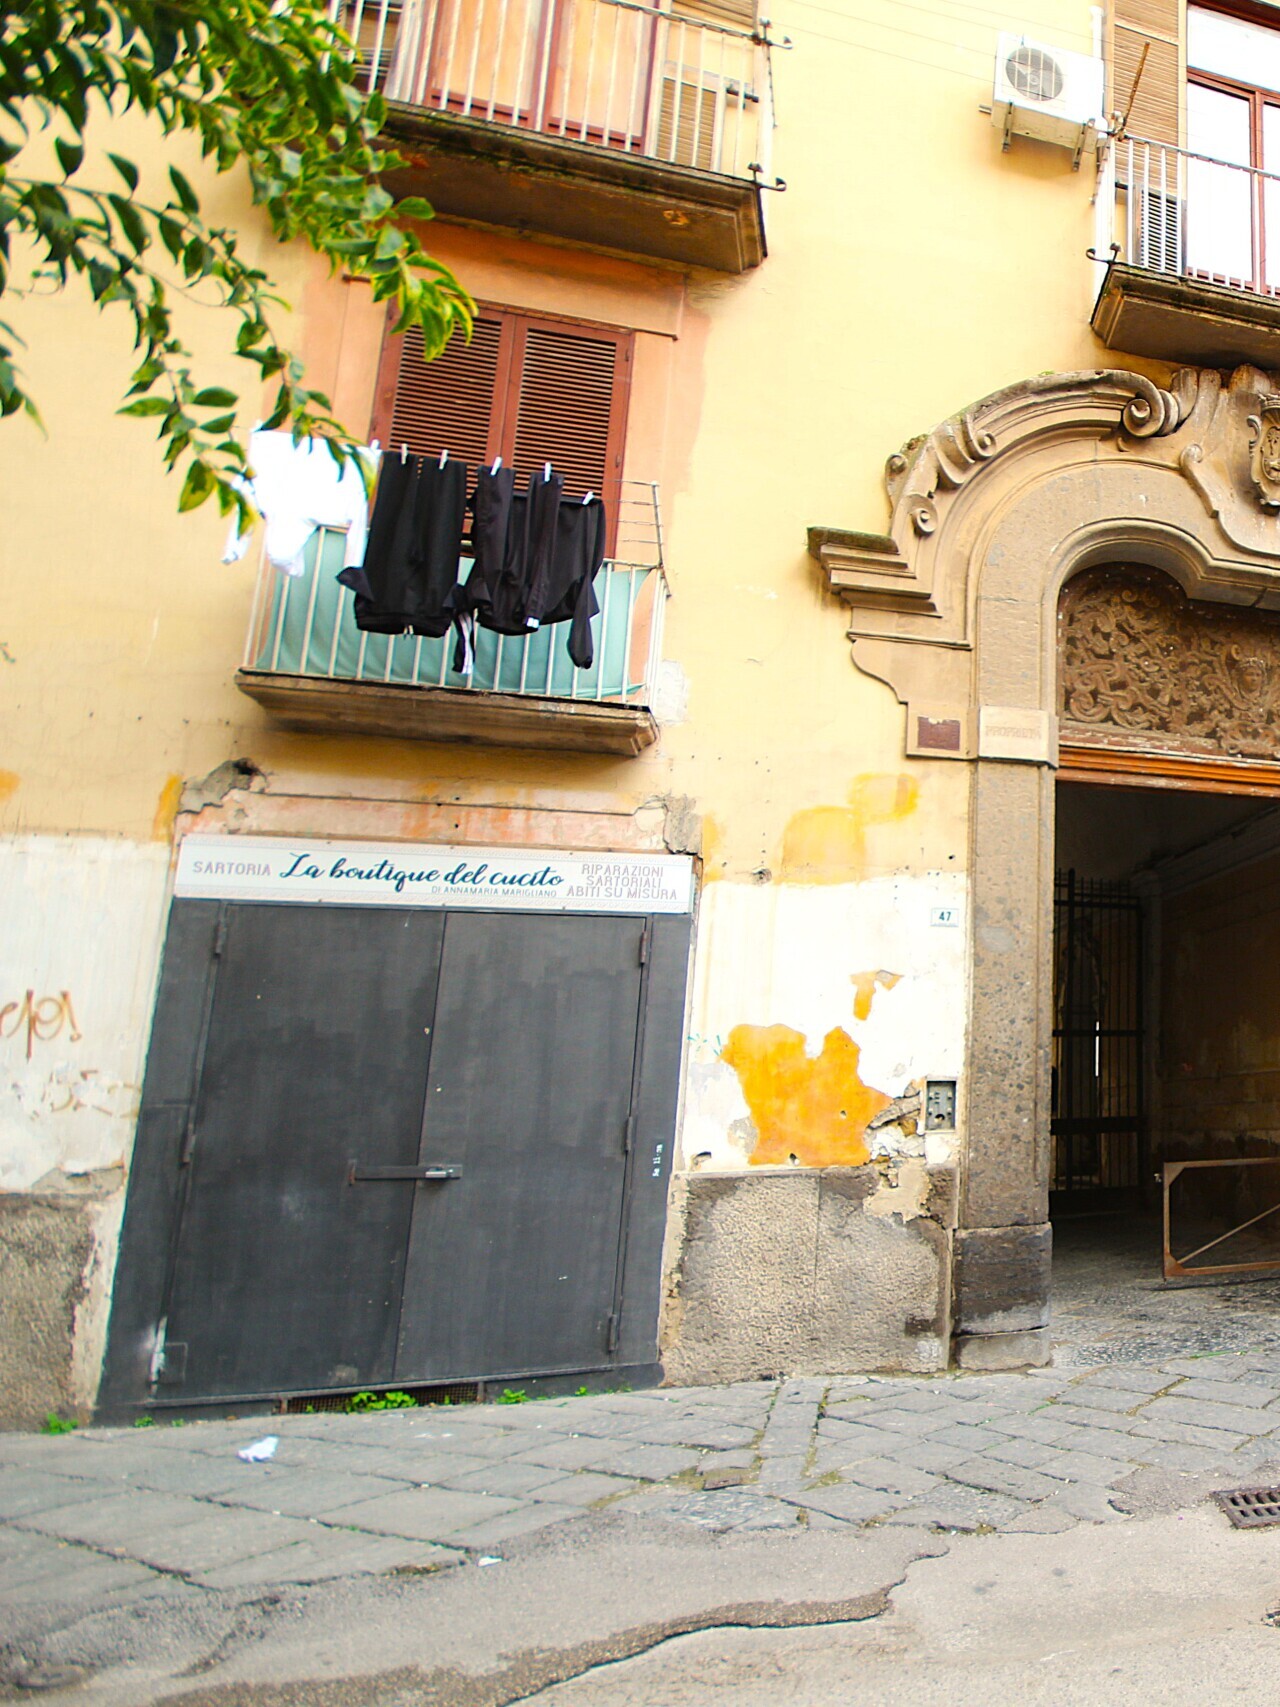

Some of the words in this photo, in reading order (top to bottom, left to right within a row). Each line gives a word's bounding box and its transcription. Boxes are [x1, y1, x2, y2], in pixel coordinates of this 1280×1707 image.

[193, 861, 271, 876] SARTORIA
[279, 852, 326, 878] La
[328, 858, 440, 892] boutique
[443, 862, 489, 885] del
[489, 866, 565, 887] cucito
[581, 863, 664, 877] RIPARAZIONI
[586, 875, 662, 889] SARTORIALI
[431, 885, 442, 894] DI
[443, 886, 499, 896] ANNAMARIA
[502, 888, 557, 898] MARIGLIANO
[566, 885, 601, 898] ABITI
[604, 886, 623, 898] SU
[626, 887, 678, 900] MISURA
[939, 911, 951, 921] 47
